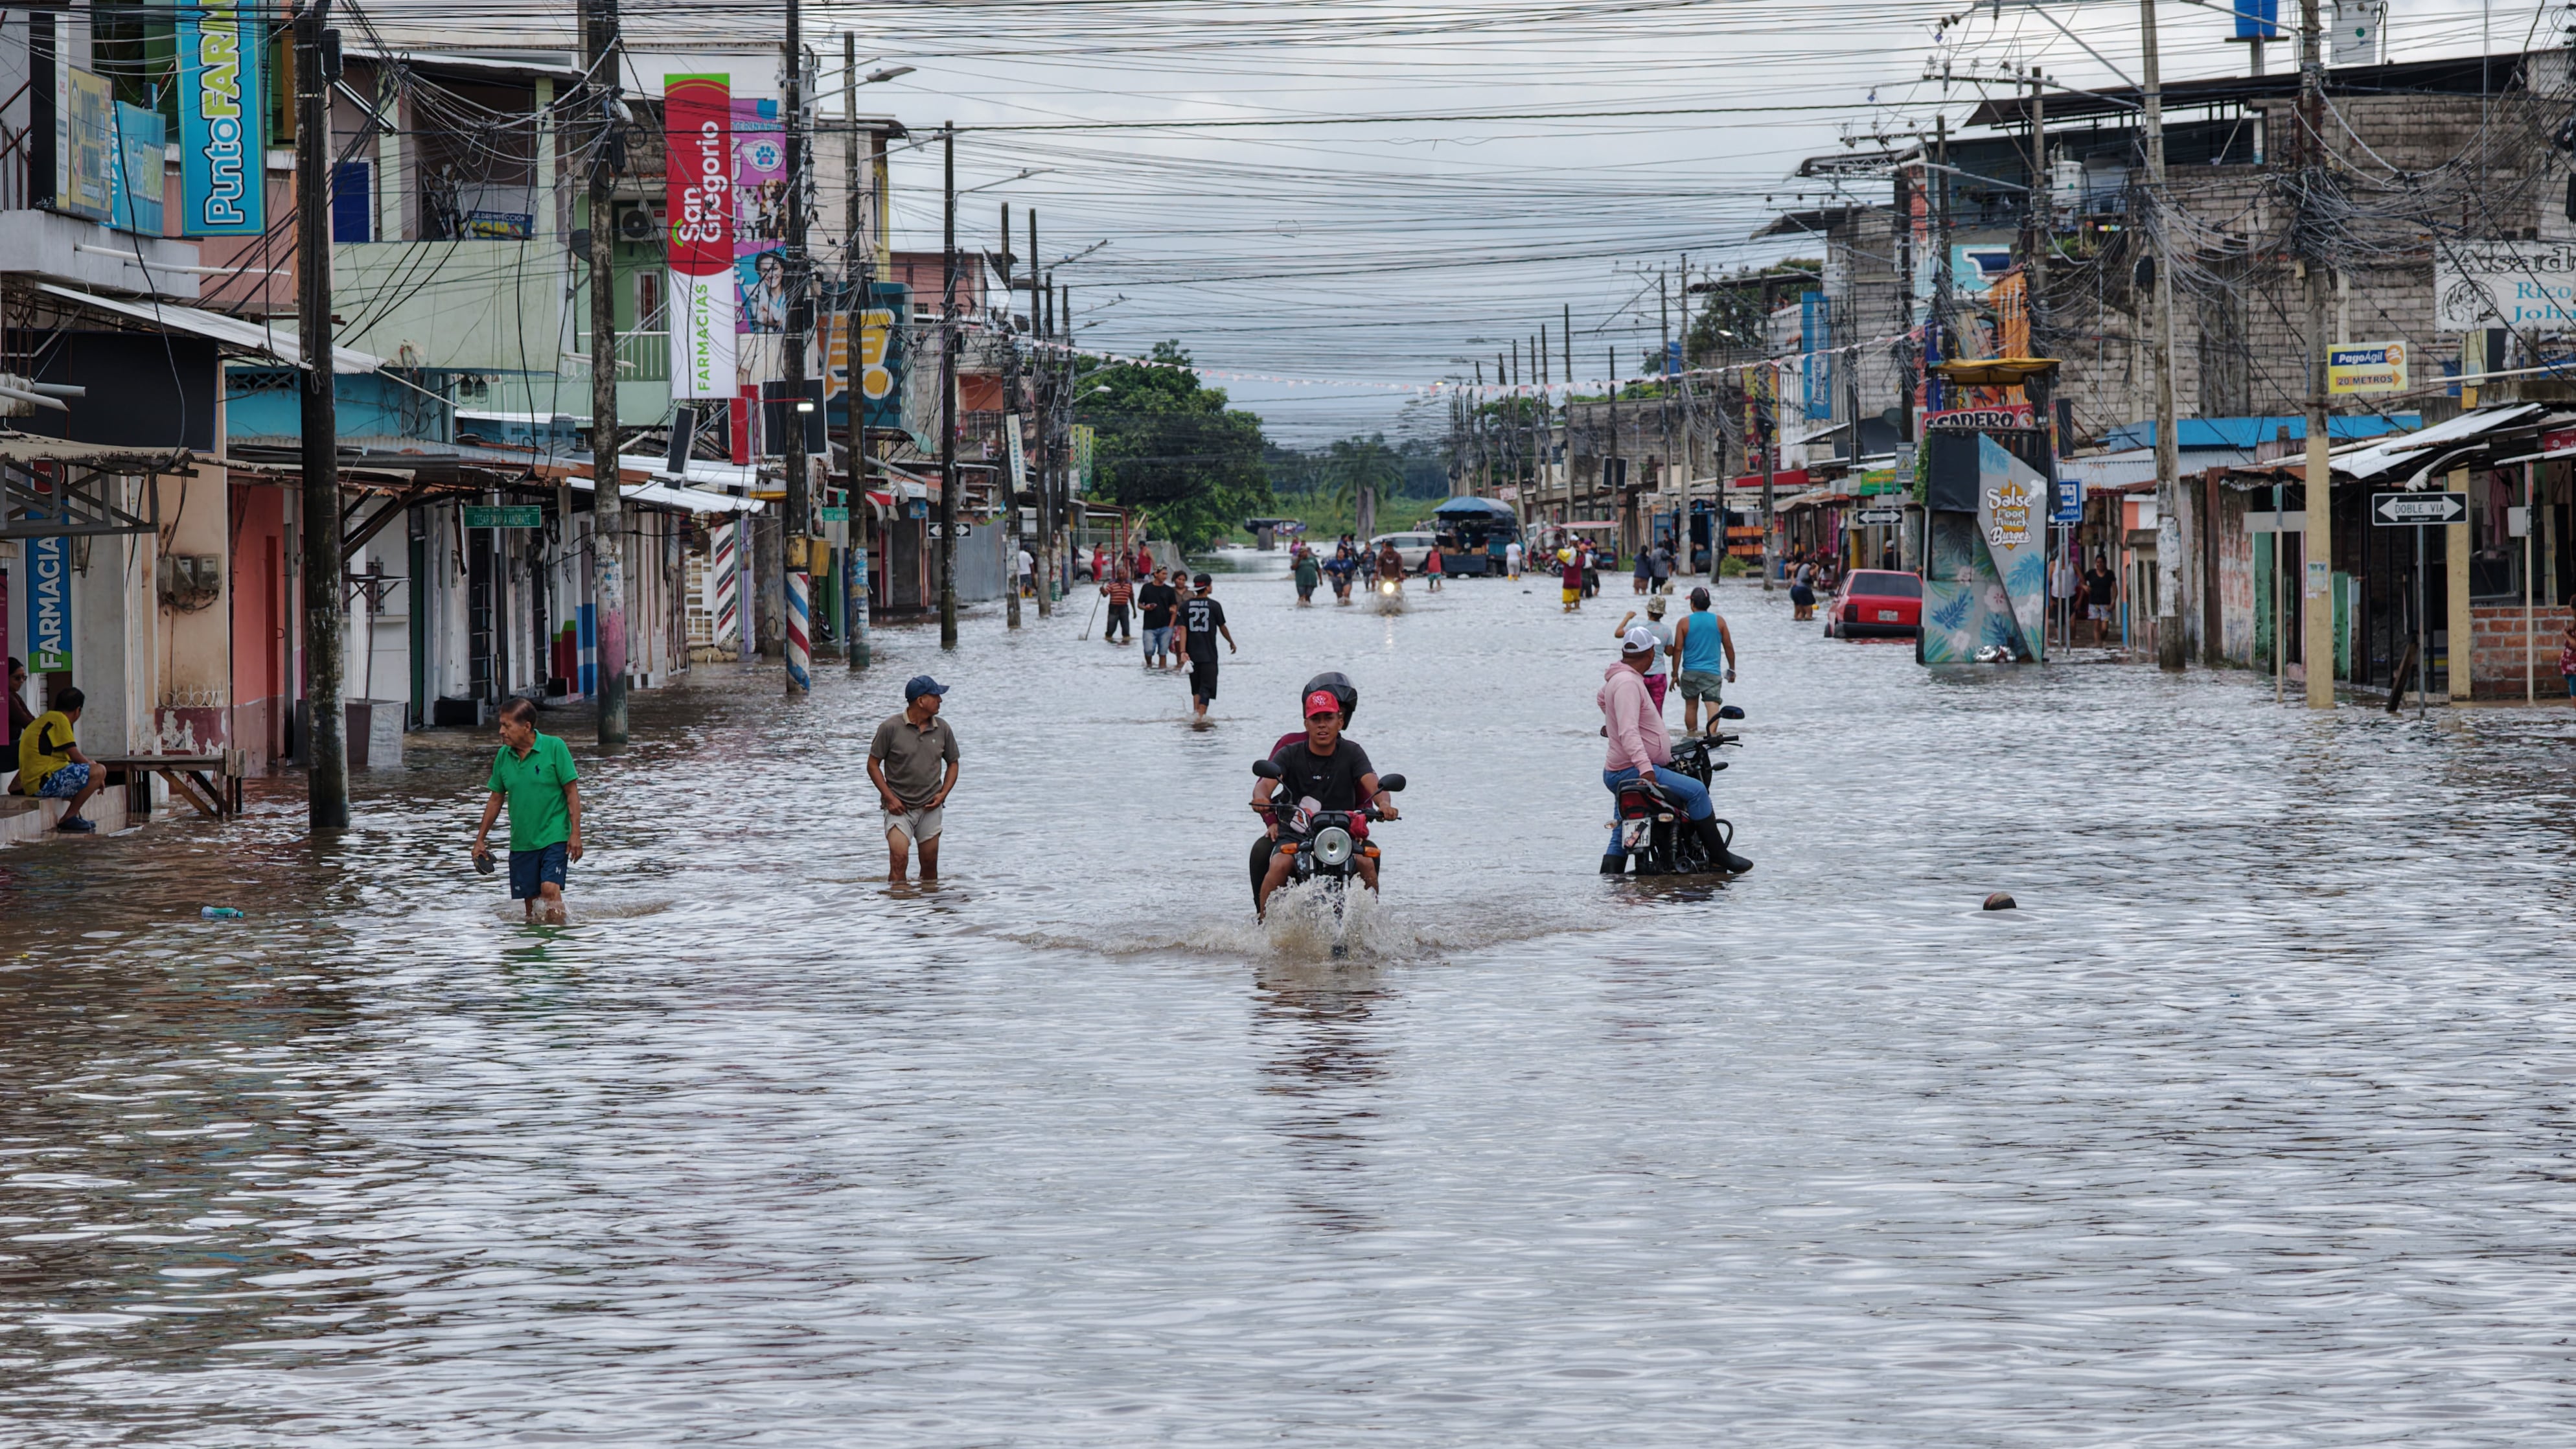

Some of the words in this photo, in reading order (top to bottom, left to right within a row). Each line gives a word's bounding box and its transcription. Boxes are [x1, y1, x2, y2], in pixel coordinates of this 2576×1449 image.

[696, 121, 728, 243] Gregorio
[678, 187, 702, 242] San
[2444, 246, 2576, 274] Asad
[2516, 282, 2571, 299] Rico
[695, 284, 710, 391] FARMACIAS
[2352, 375, 2393, 384] METROS
[1997, 509, 2025, 518] Food
[2395, 504, 2424, 514] DOBLE
[2430, 503, 2445, 513] VIA
[1188, 607, 1210, 632] 23
